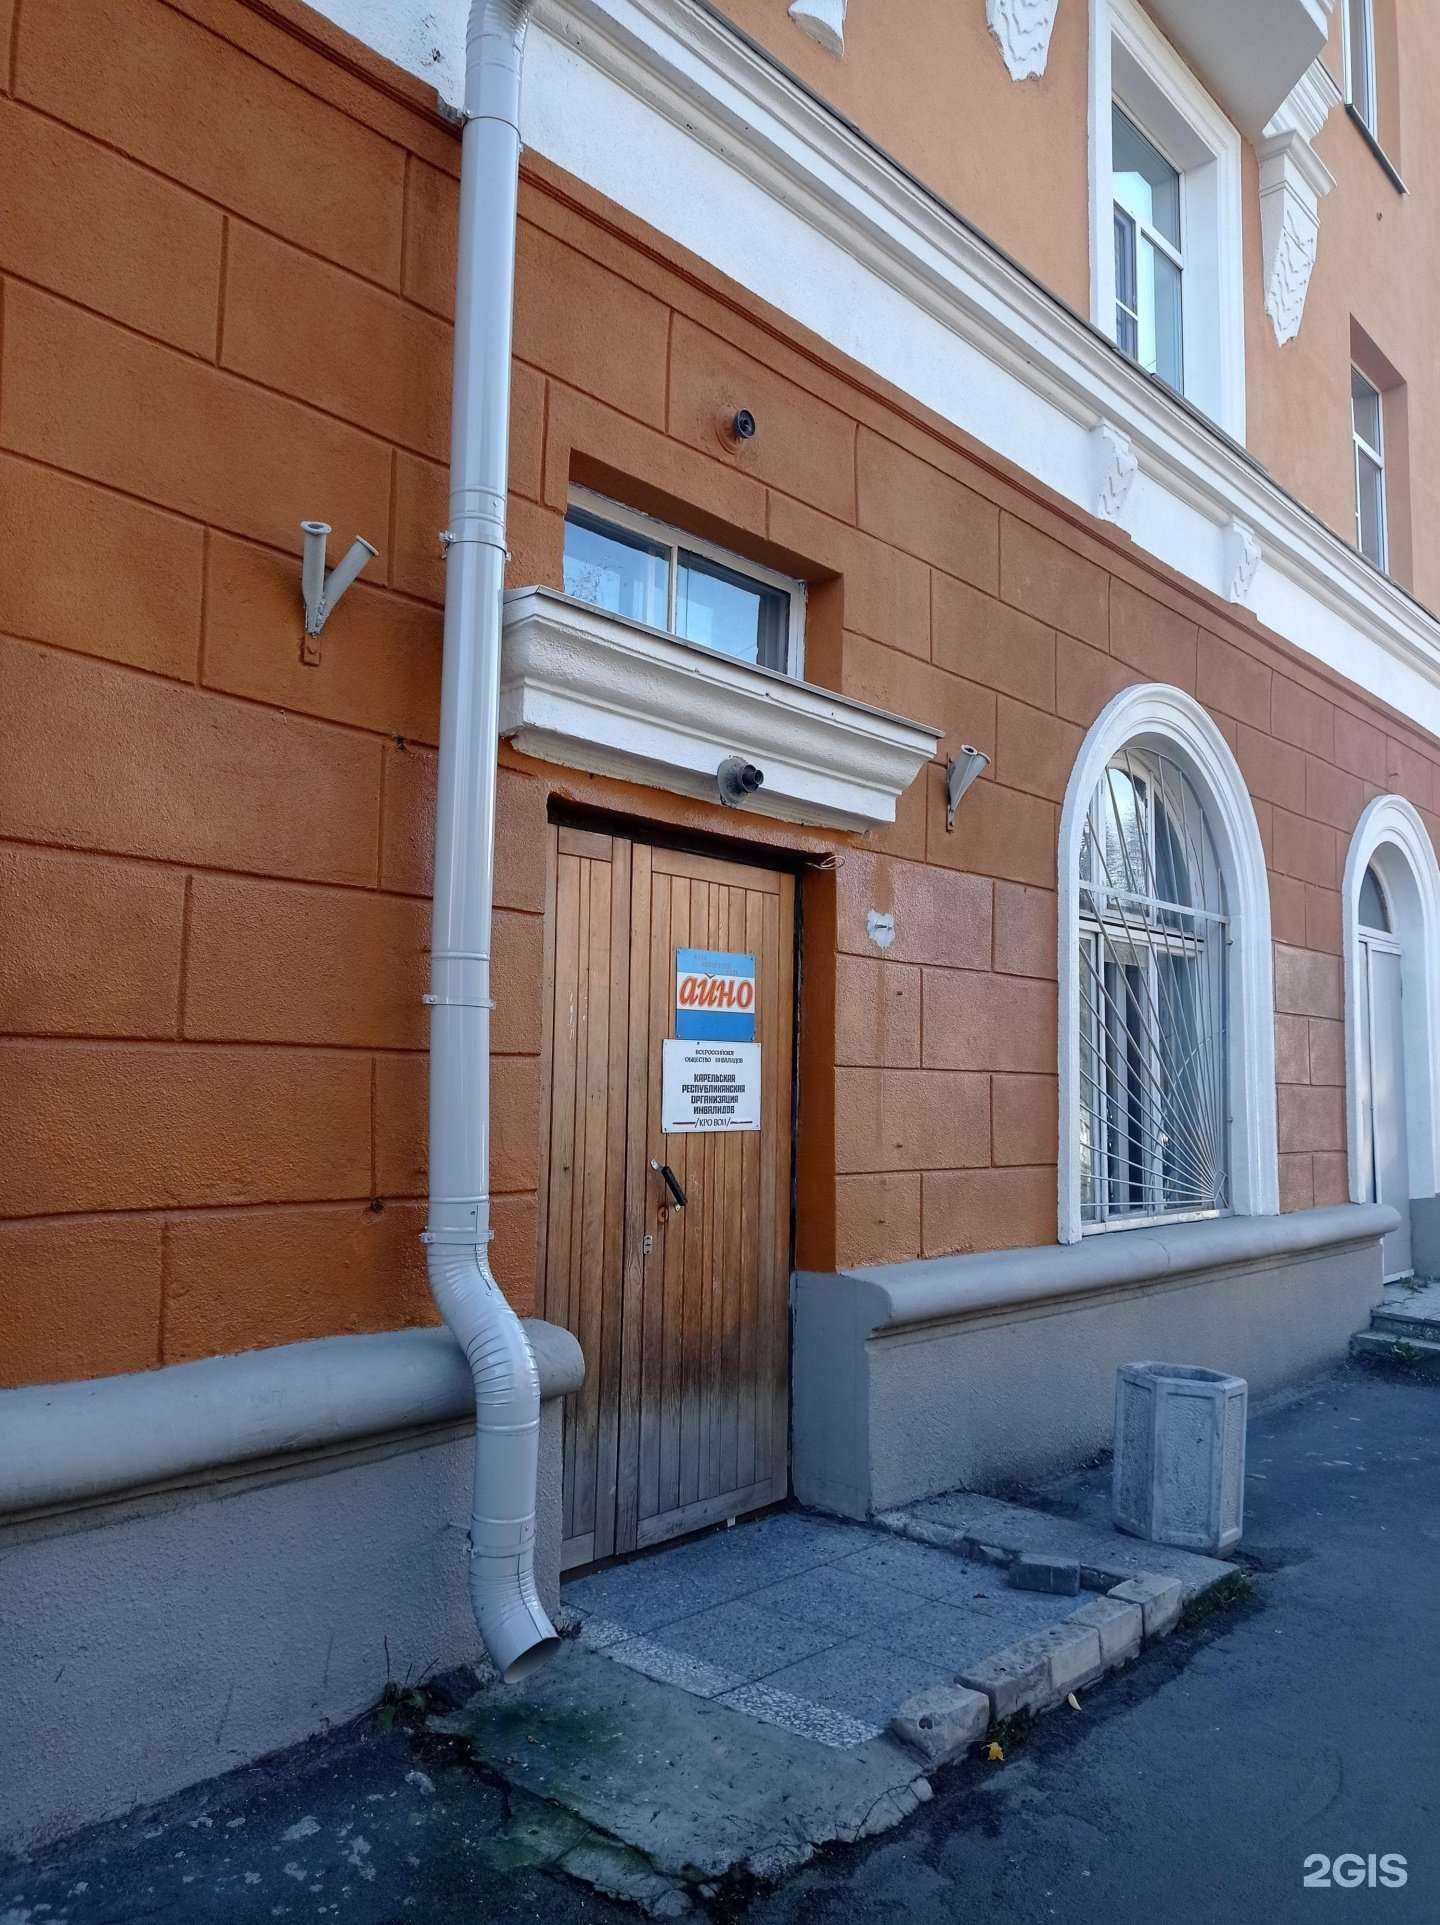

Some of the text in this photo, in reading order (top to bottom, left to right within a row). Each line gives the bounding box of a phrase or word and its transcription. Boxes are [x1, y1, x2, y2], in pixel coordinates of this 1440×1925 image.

[693, 1073, 736, 1083] КАРЕЛЬСКАЯ
[681, 1084, 745, 1093] РЕСПУБЛИКАНСКАЯ
[690, 1095, 738, 1104] ОРГАНИЗАЦИЯ
[693, 1105, 735, 1114] ИНВАЛИДОВ
